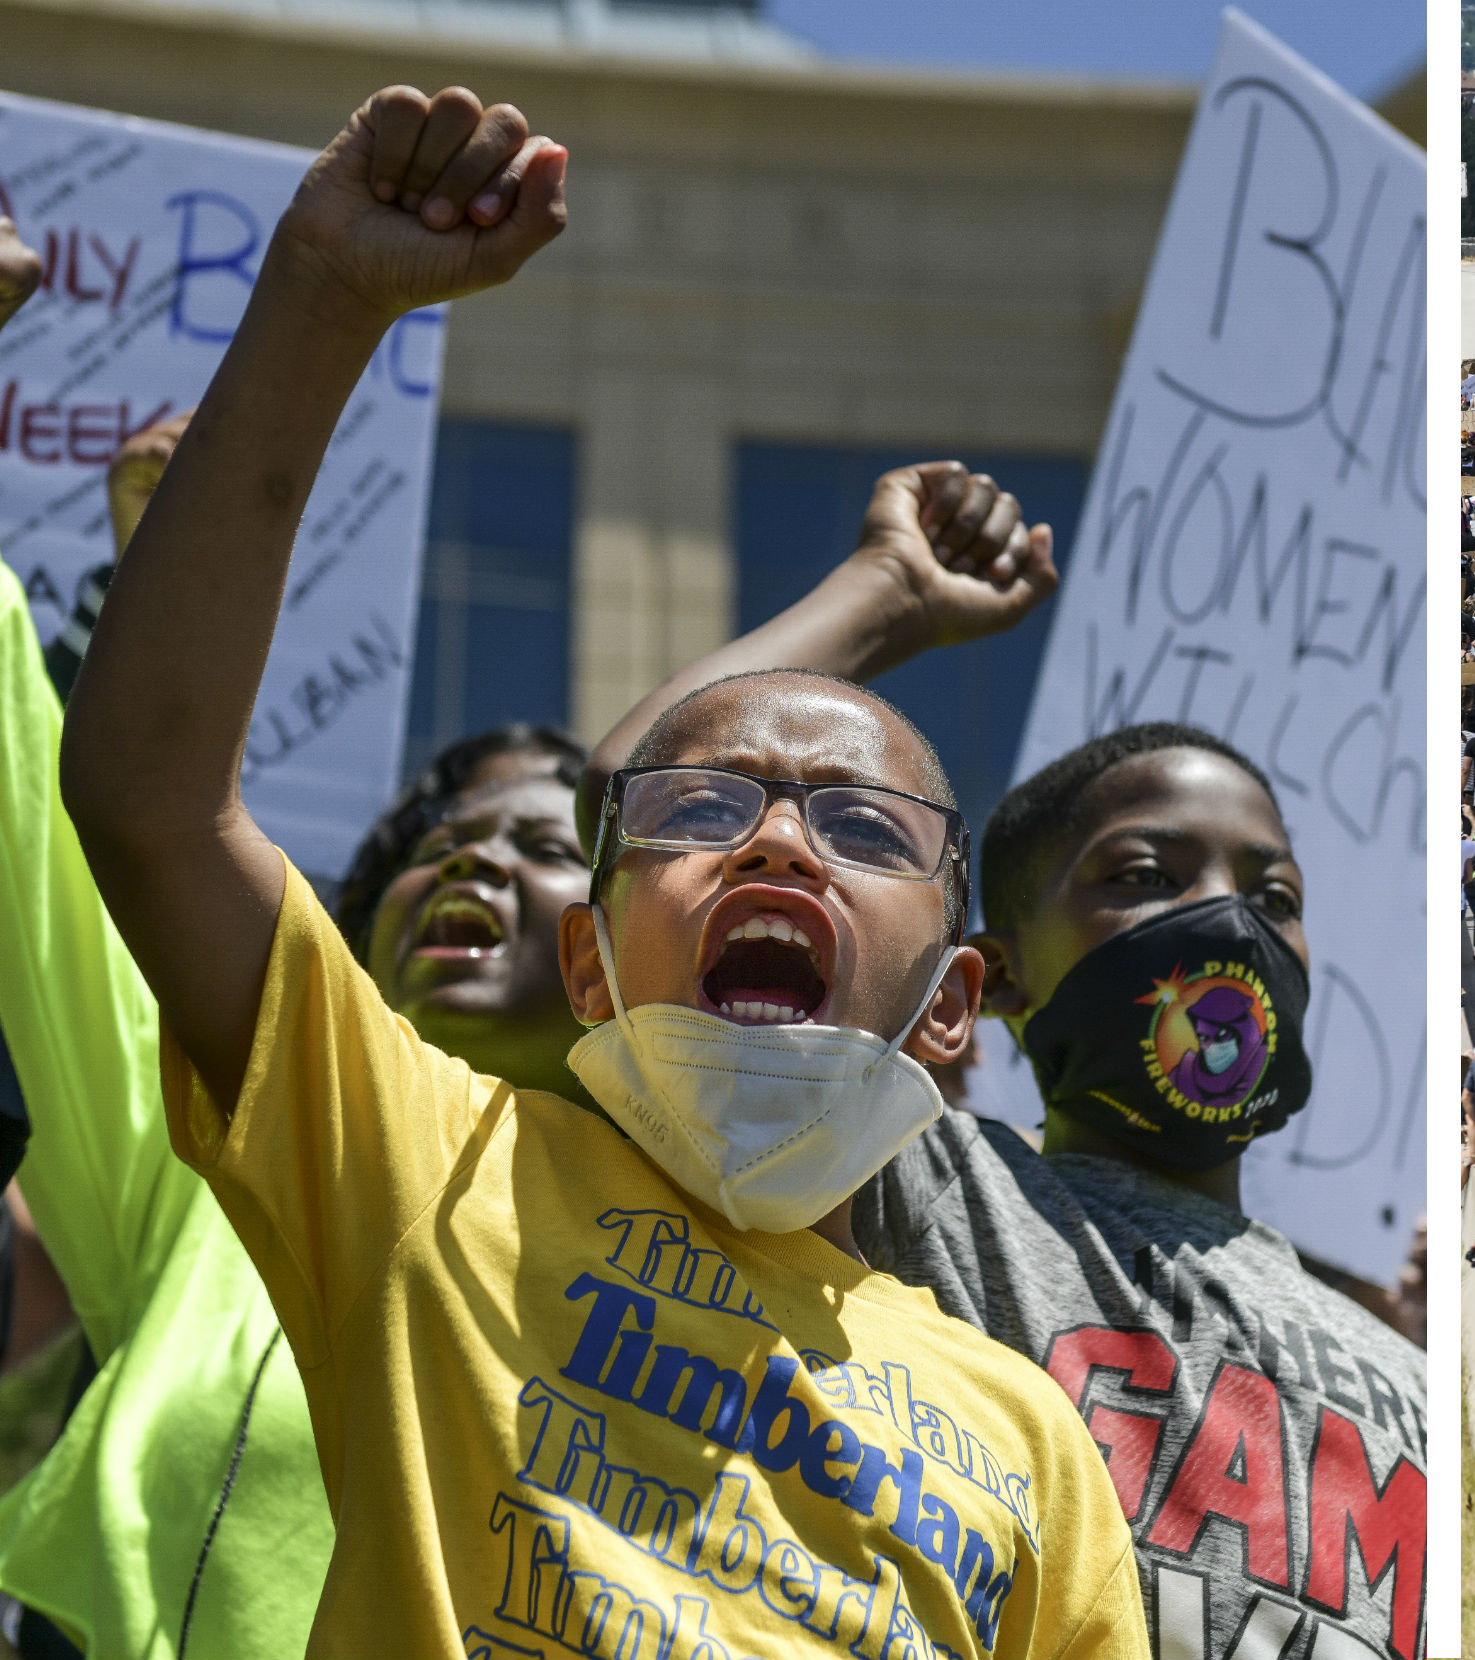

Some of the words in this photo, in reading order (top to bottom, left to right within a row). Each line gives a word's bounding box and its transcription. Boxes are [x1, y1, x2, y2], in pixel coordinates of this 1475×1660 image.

[1139, 1039, 1243, 1123] FIREWORKS
[1203, 960, 1279, 1055] PHANTOM
[558, 1270, 1017, 1653] Timberland
[597, 1206, 1041, 1556] Timerland
